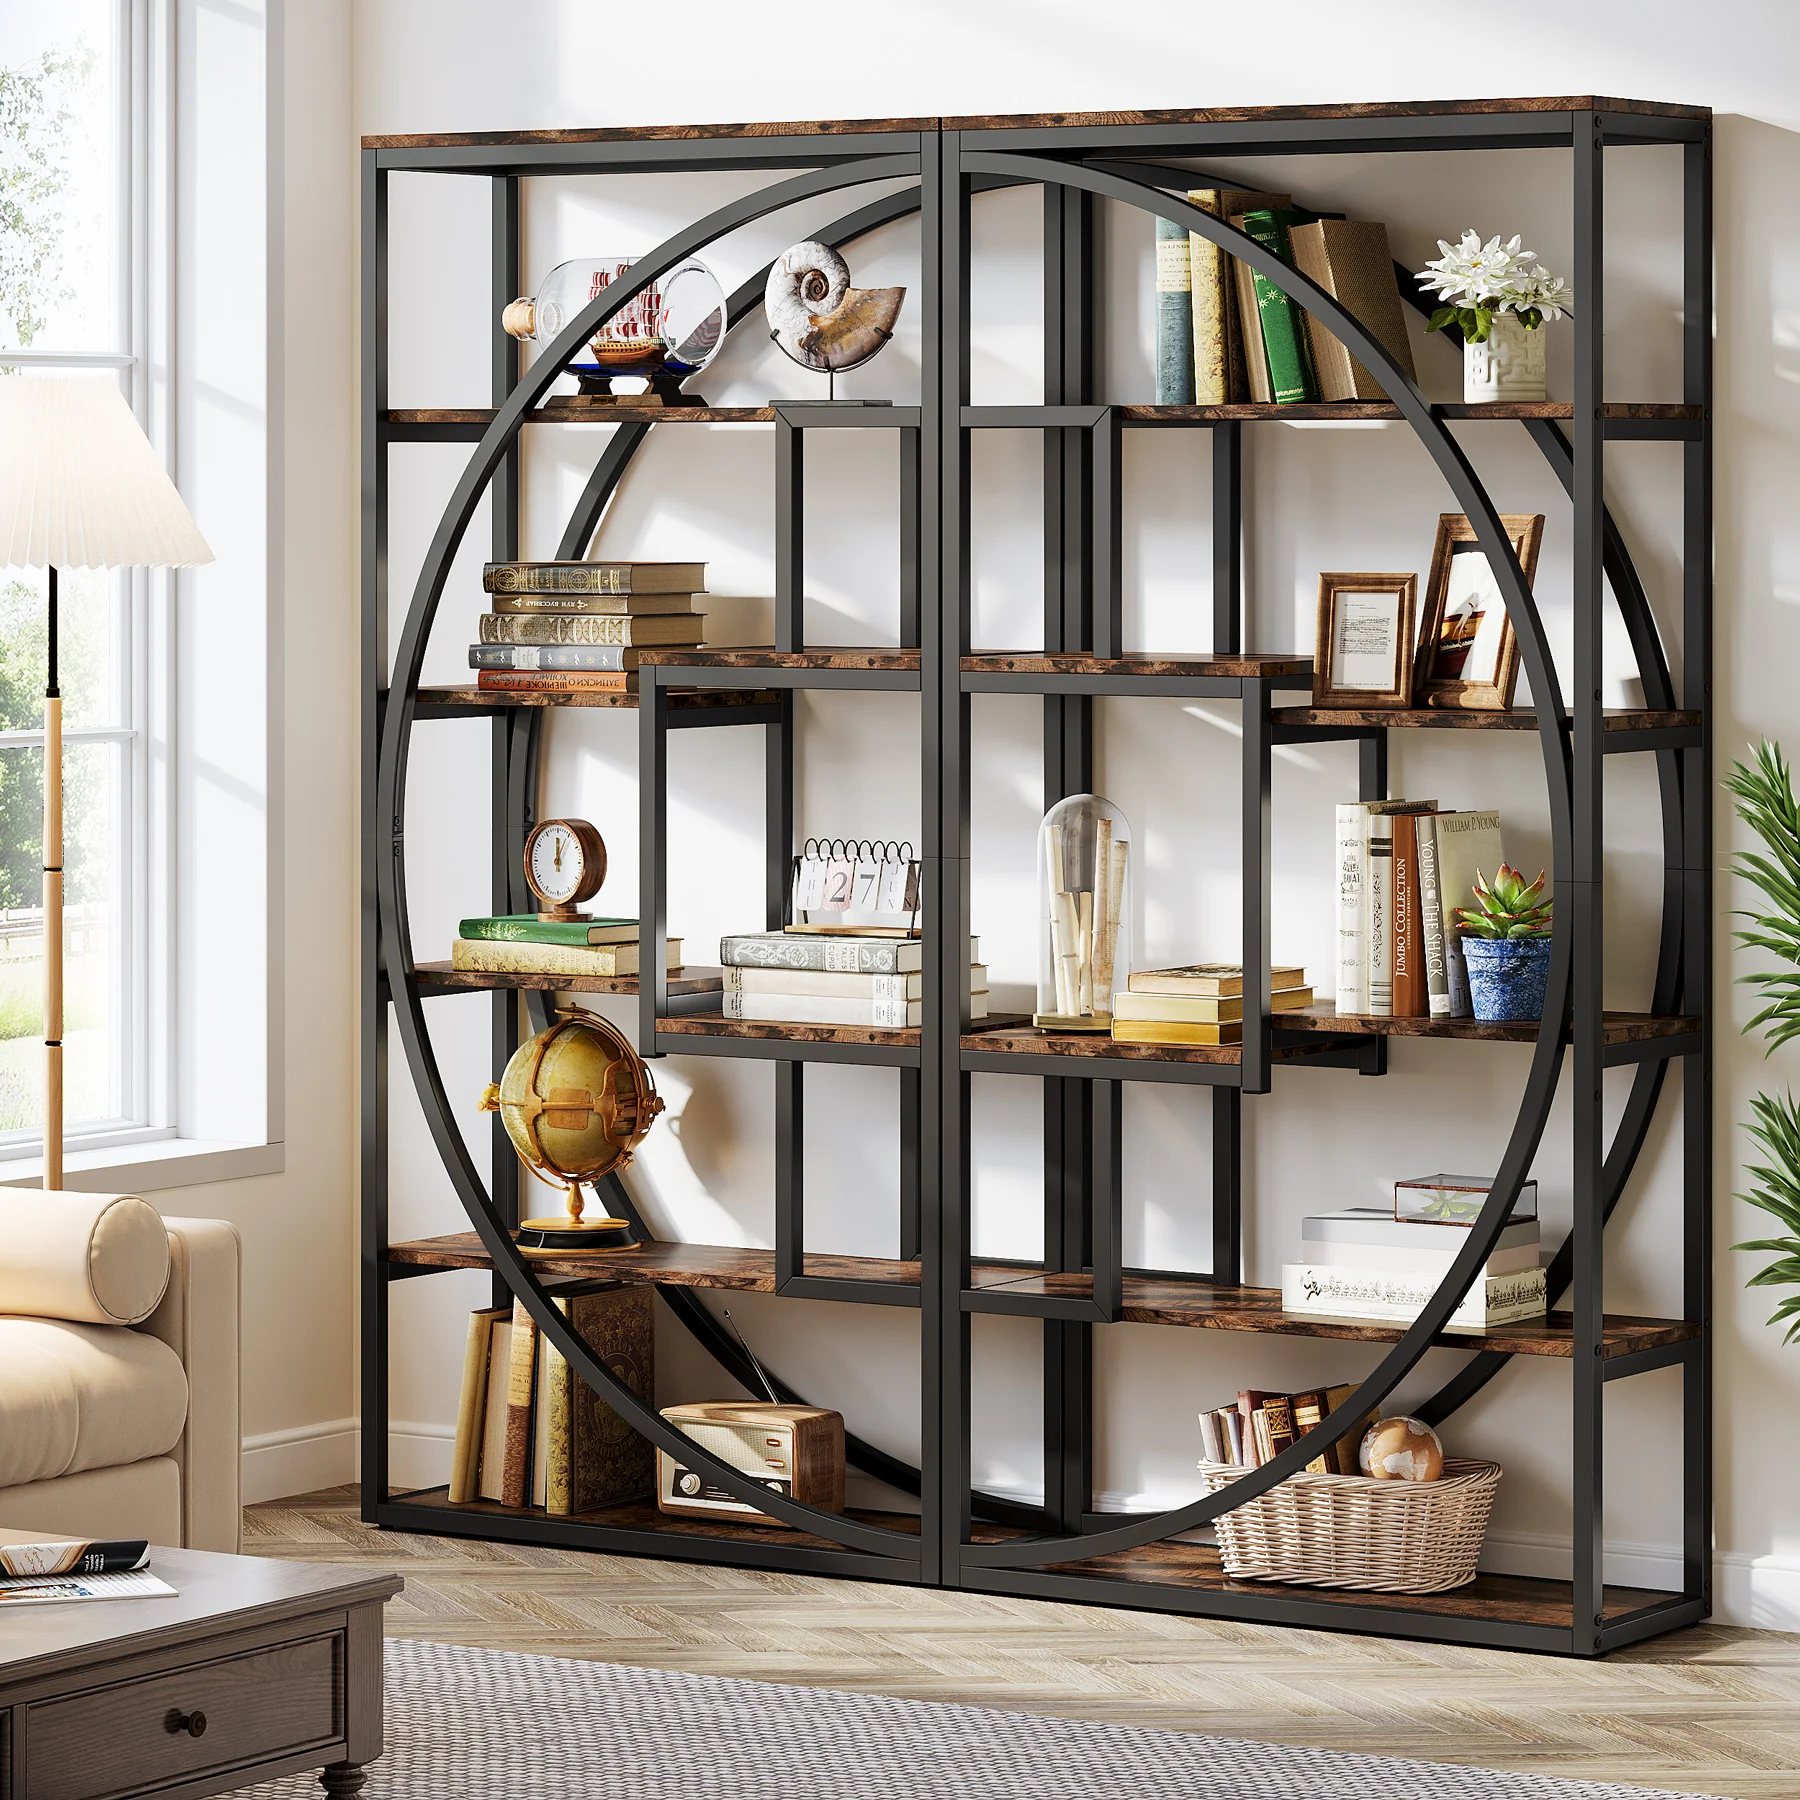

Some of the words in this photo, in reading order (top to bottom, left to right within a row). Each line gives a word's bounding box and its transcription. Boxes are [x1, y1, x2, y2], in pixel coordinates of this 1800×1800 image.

[526, 681, 568, 690] ШЕРЛОКЕ
[577, 678, 620, 688] ЗАПИСКИ
[1442, 818, 1471, 833] WILLIAM
[1471, 817, 1477, 831] P.
[1476, 816, 1501, 831] YOUNG
[1421, 839, 1436, 888] YOUNG
[806, 861, 818, 908] THU
[888, 864, 899, 910] JUN
[1395, 858, 1406, 933] COLLECTION
[1425, 902, 1440, 930] THE
[828, 945, 836, 970] CUPID
[840, 946, 848, 970] TALES
[1395, 936, 1409, 978] JUMBO
[1426, 933, 1444, 978] SHACK
